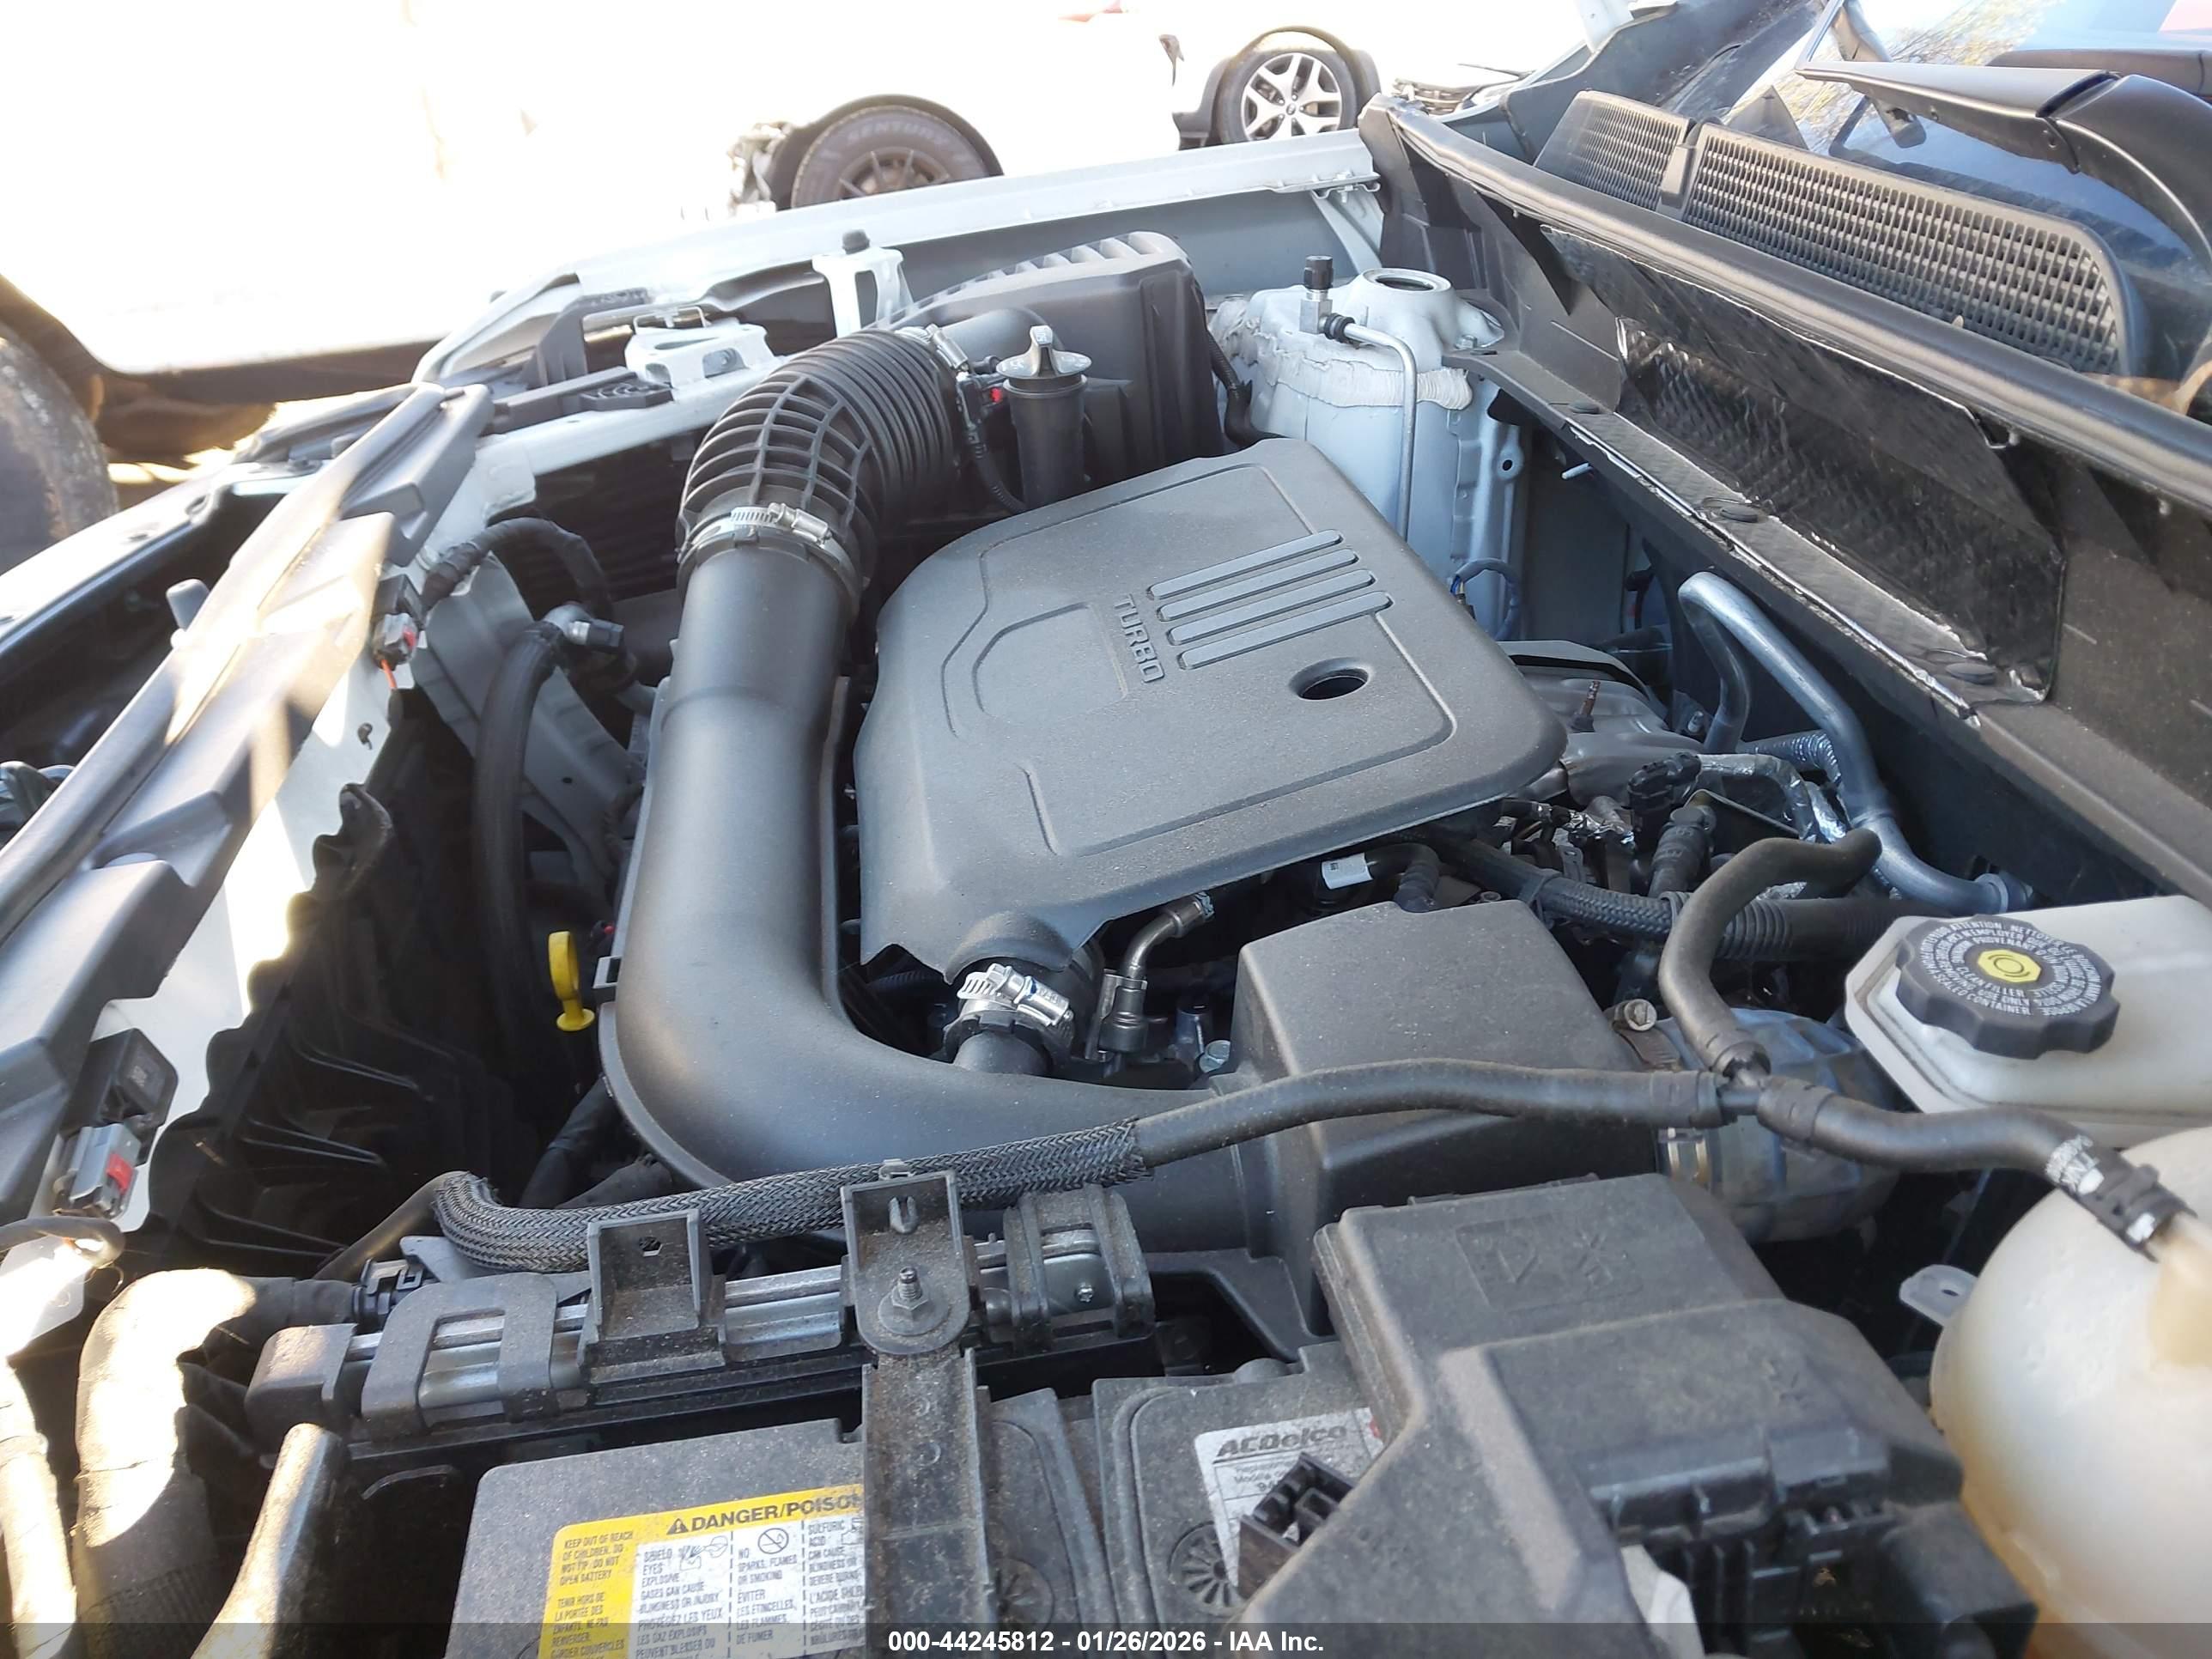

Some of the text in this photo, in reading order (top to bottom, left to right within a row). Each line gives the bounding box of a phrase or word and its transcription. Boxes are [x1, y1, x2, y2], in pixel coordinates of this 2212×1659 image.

[1114, 594, 1165, 684] TURBO
[2010, 925, 2063, 947] NETTOYER
[2072, 955, 2100, 981] BOUCHON
[1933, 974, 1968, 996] SEALED
[1216, 1425, 1347, 1457] ACDelco
[808, 1520, 844, 1535] SULFURIC
[564, 1530, 634, 1549] KEEP OUT OF REACH
[809, 1535, 825, 1547] ACID
[738, 1547, 750, 1559] NO
[605, 1555, 620, 1566] NOT
[643, 1563, 663, 1575] EYES
[559, 1574, 579, 1586] OPEN
[642, 1572, 680, 1588] EXPLOSIVE
[750, 1570, 782, 1583] SMOKING
[641, 1581, 704, 1601] GASES CAN CAUSE
[681, 1596, 691, 1608] OR
[684, 1611, 699, 1625] LES
[702, 1607, 723, 1621] YEUX
[738, 1605, 750, 1617] LES
[737, 1620, 749, 1631] LES
[637, 1634, 650, 1646] LES
[737, 1630, 773, 1645] DE FUMER
